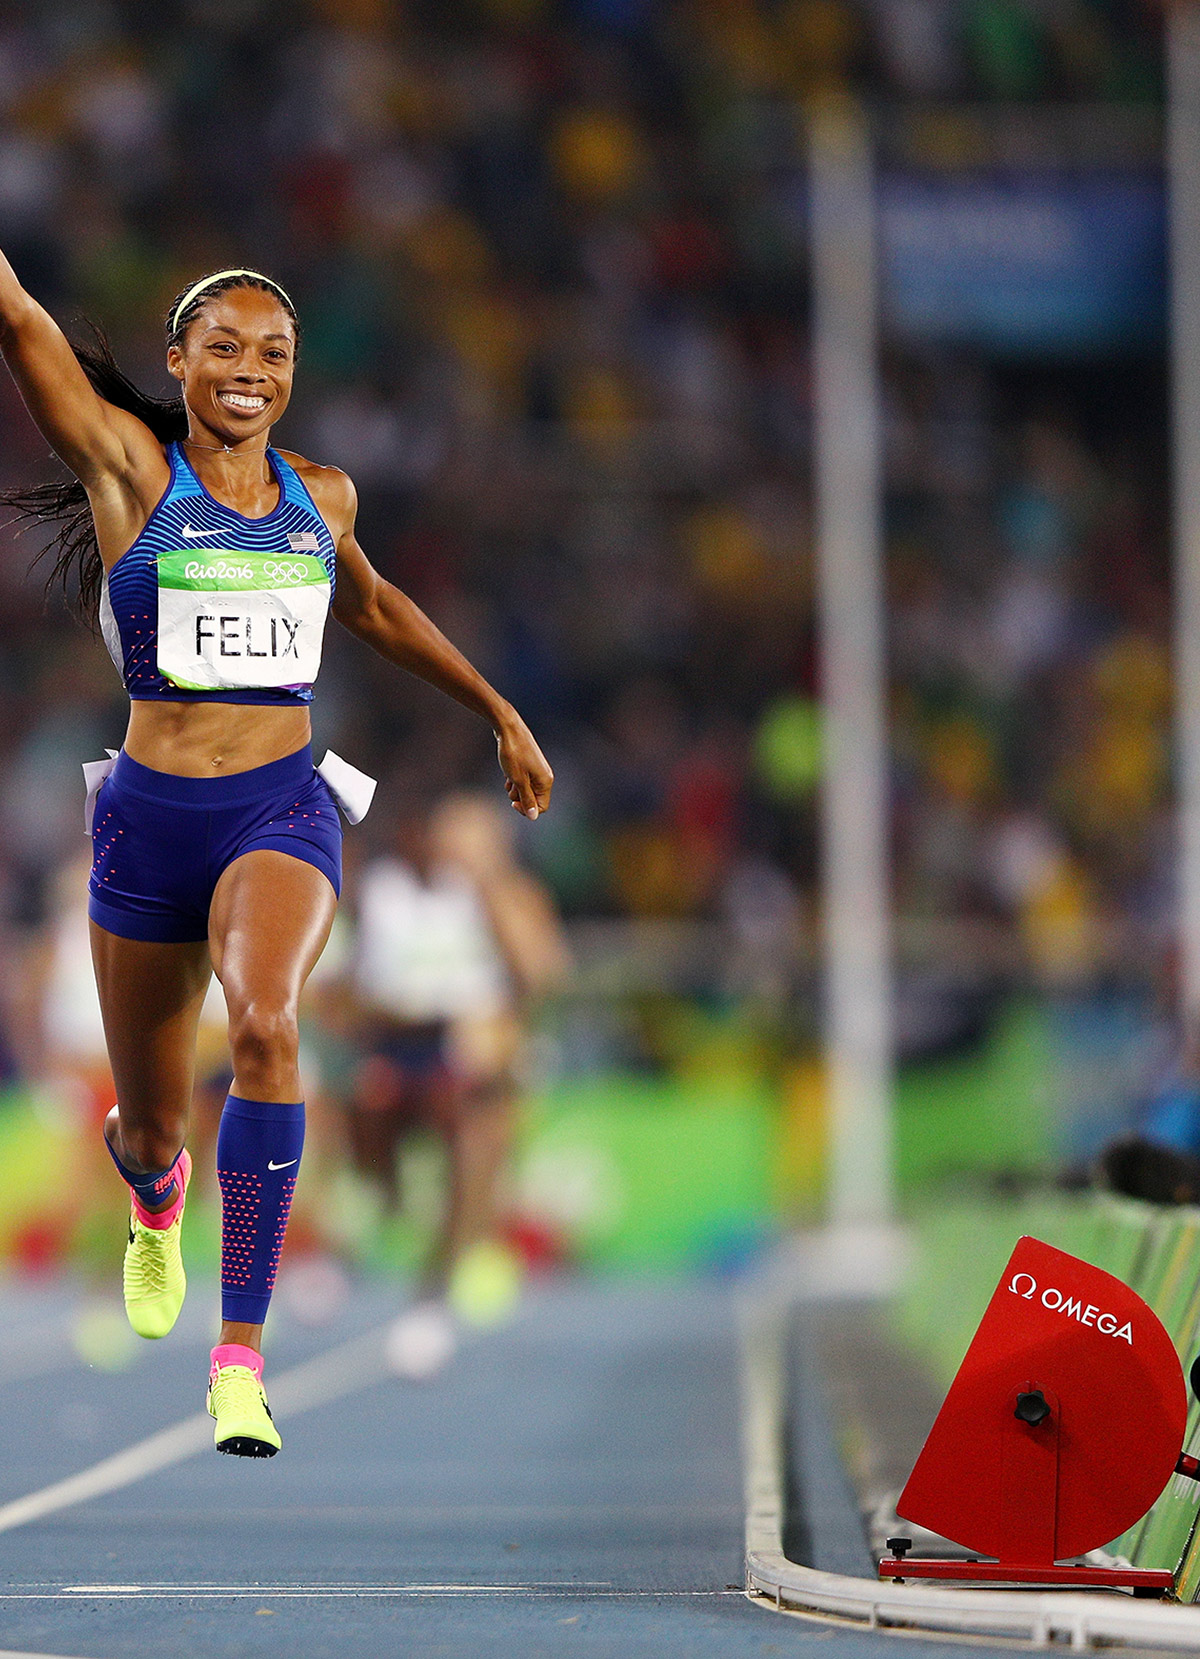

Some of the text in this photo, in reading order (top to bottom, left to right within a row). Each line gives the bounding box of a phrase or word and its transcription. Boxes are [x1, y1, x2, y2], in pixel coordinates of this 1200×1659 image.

[185, 561, 254, 579] Rio2016
[196, 615, 302, 659] FELIX
[1041, 1288, 1133, 1345] OMEGA
